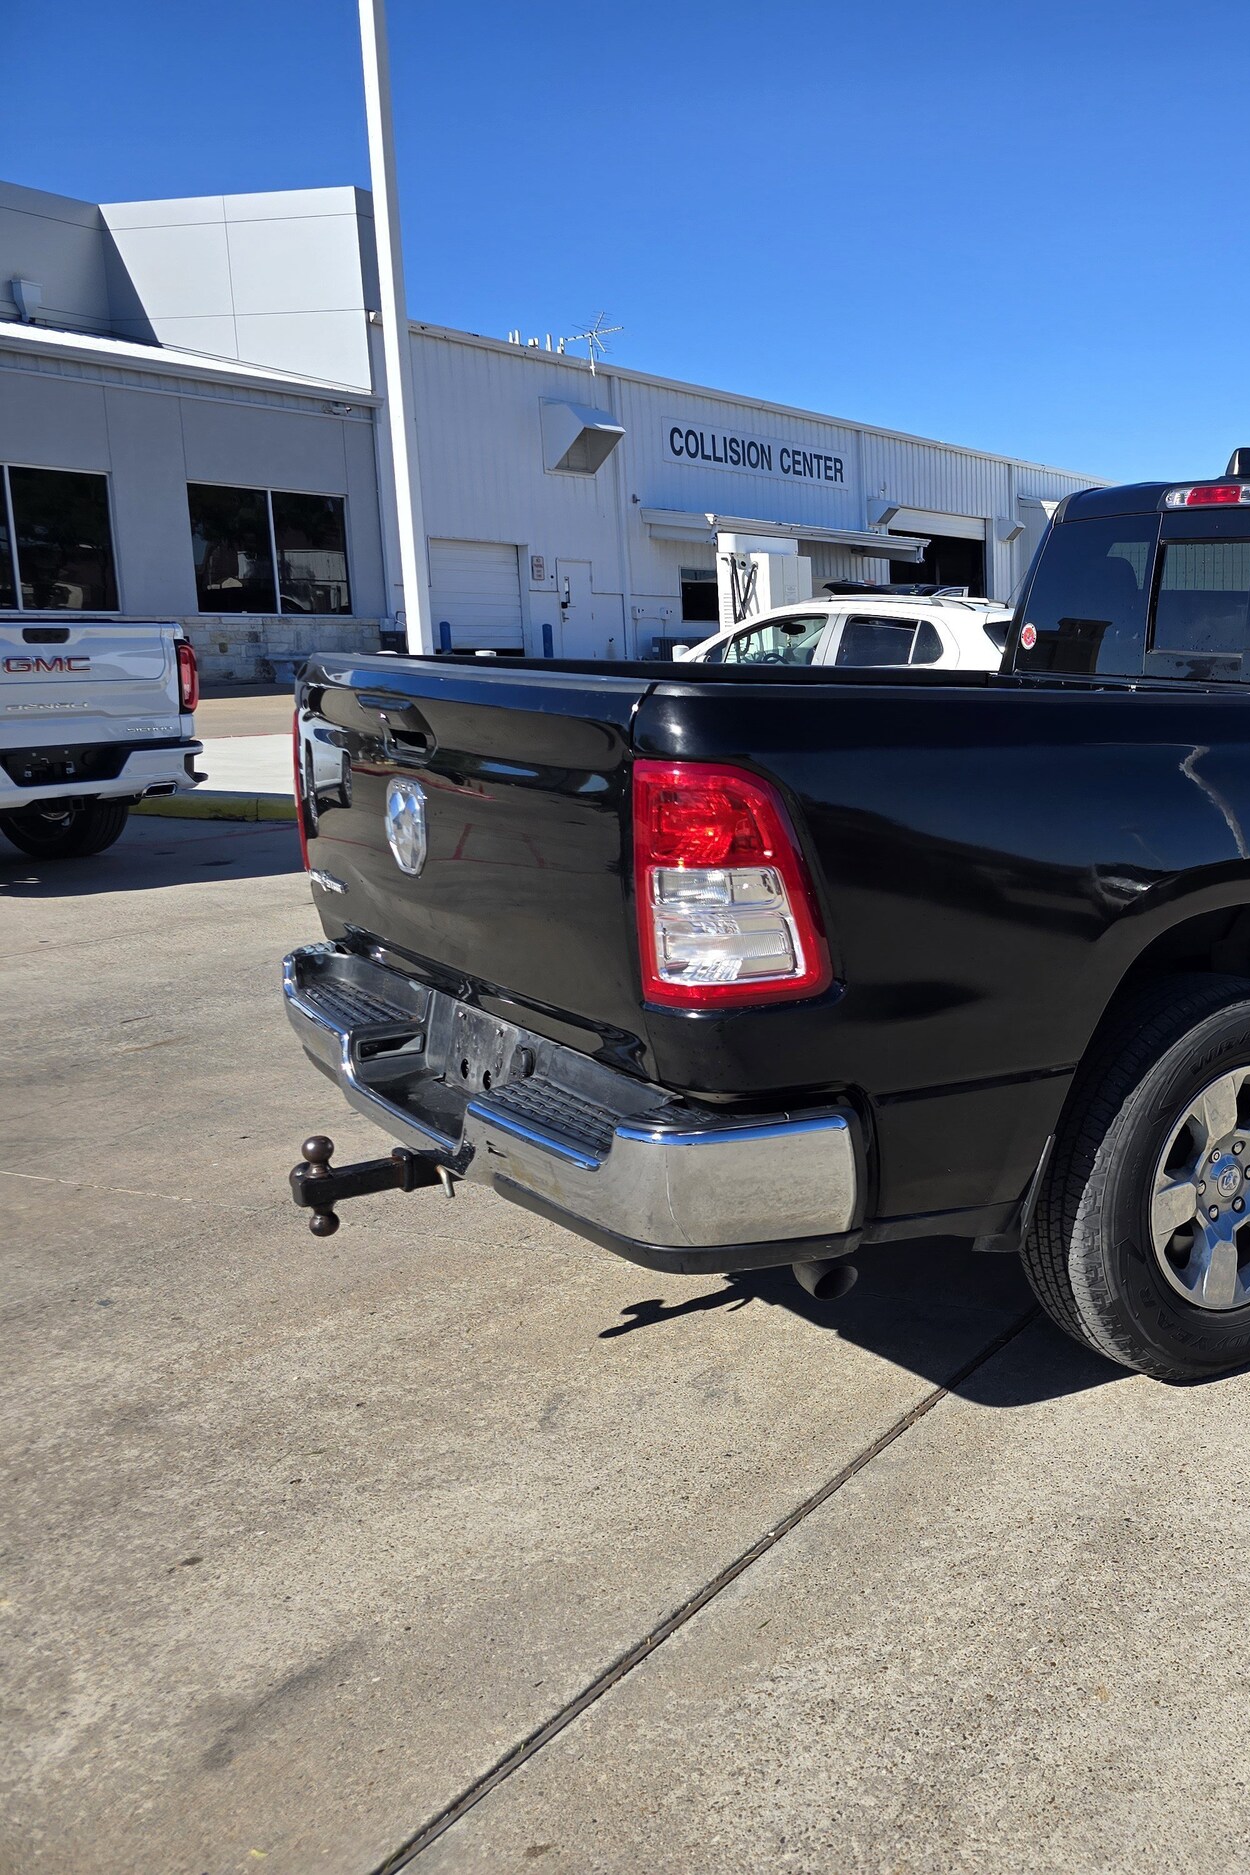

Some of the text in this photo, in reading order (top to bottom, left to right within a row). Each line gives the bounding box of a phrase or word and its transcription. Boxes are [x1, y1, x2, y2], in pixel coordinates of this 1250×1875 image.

[669, 427, 844, 483] COLLISION CENTER
[3, 656, 92, 673] GMC
